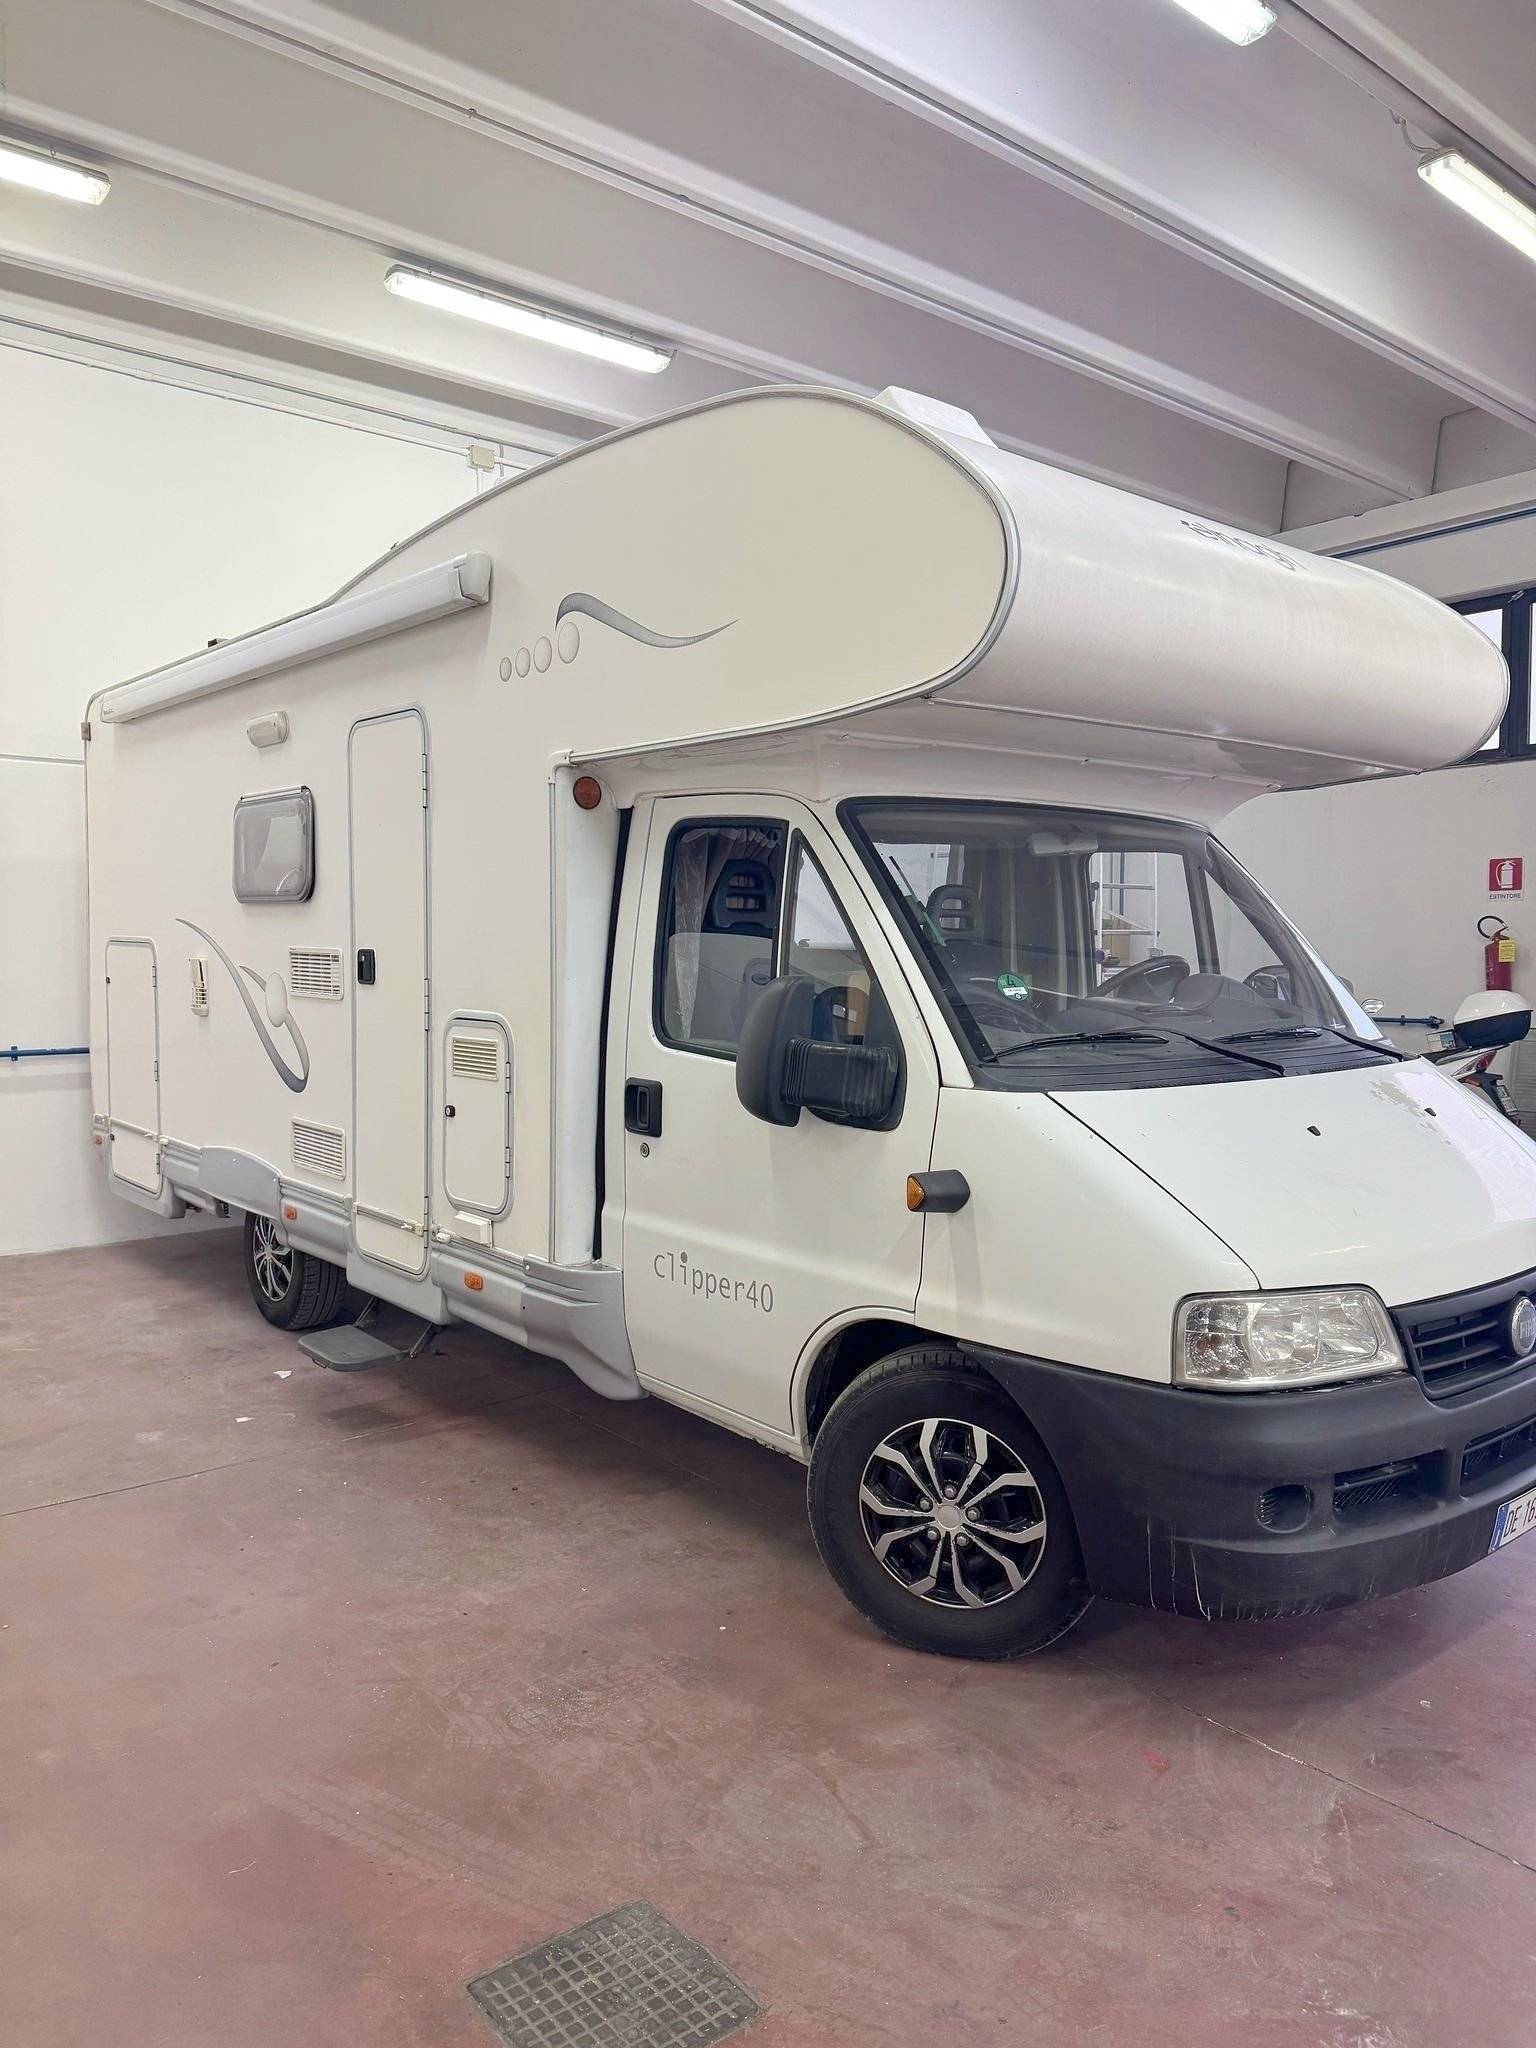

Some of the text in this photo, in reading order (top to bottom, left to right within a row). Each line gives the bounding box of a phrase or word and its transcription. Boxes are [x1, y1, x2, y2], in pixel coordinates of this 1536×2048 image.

[1489, 892, 1521, 900] ESTINTORE
[1503, 1504, 1523, 1538] DE
[1522, 1496, 1536, 1527] 16
